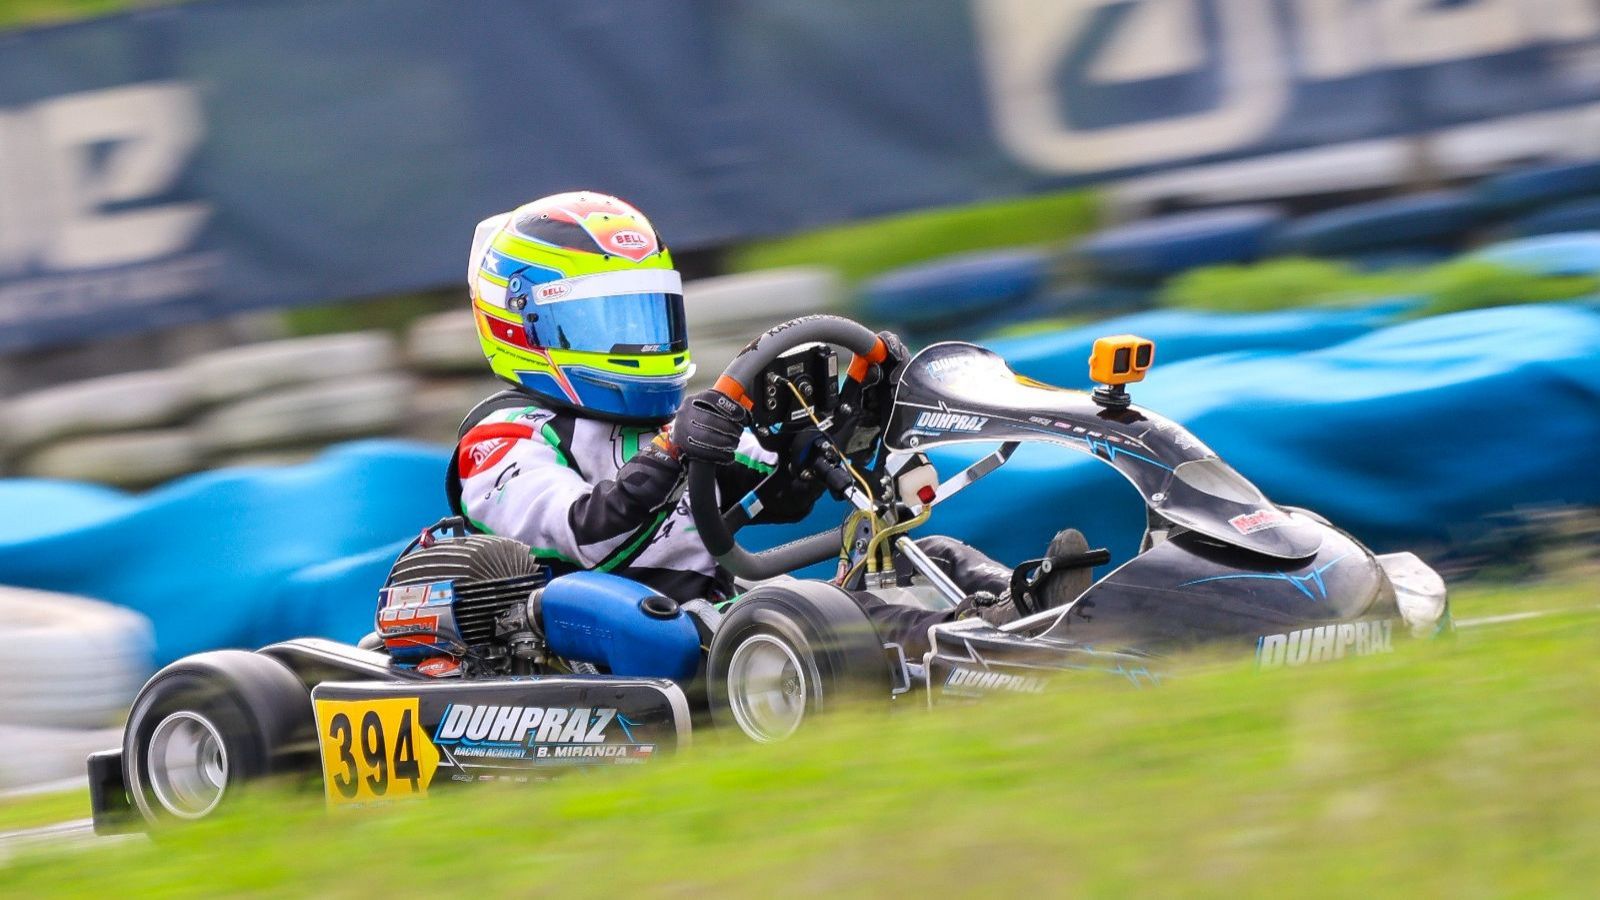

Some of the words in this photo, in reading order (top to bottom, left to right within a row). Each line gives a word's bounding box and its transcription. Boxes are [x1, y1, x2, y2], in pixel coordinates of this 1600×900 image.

[616, 234, 644, 244] BELL
[543, 285, 565, 297] BELL
[916, 411, 989, 431] DUHPRAZ
[1259, 618, 1394, 672] DUHPRAZ
[436, 703, 617, 744] DUHPRAZ
[329, 709, 420, 799] 394
[454, 747, 486, 757] RACING
[486, 748, 528, 758] ACADEMY
[536, 746, 552, 758] B.
[554, 746, 627, 757] MIRANDA
